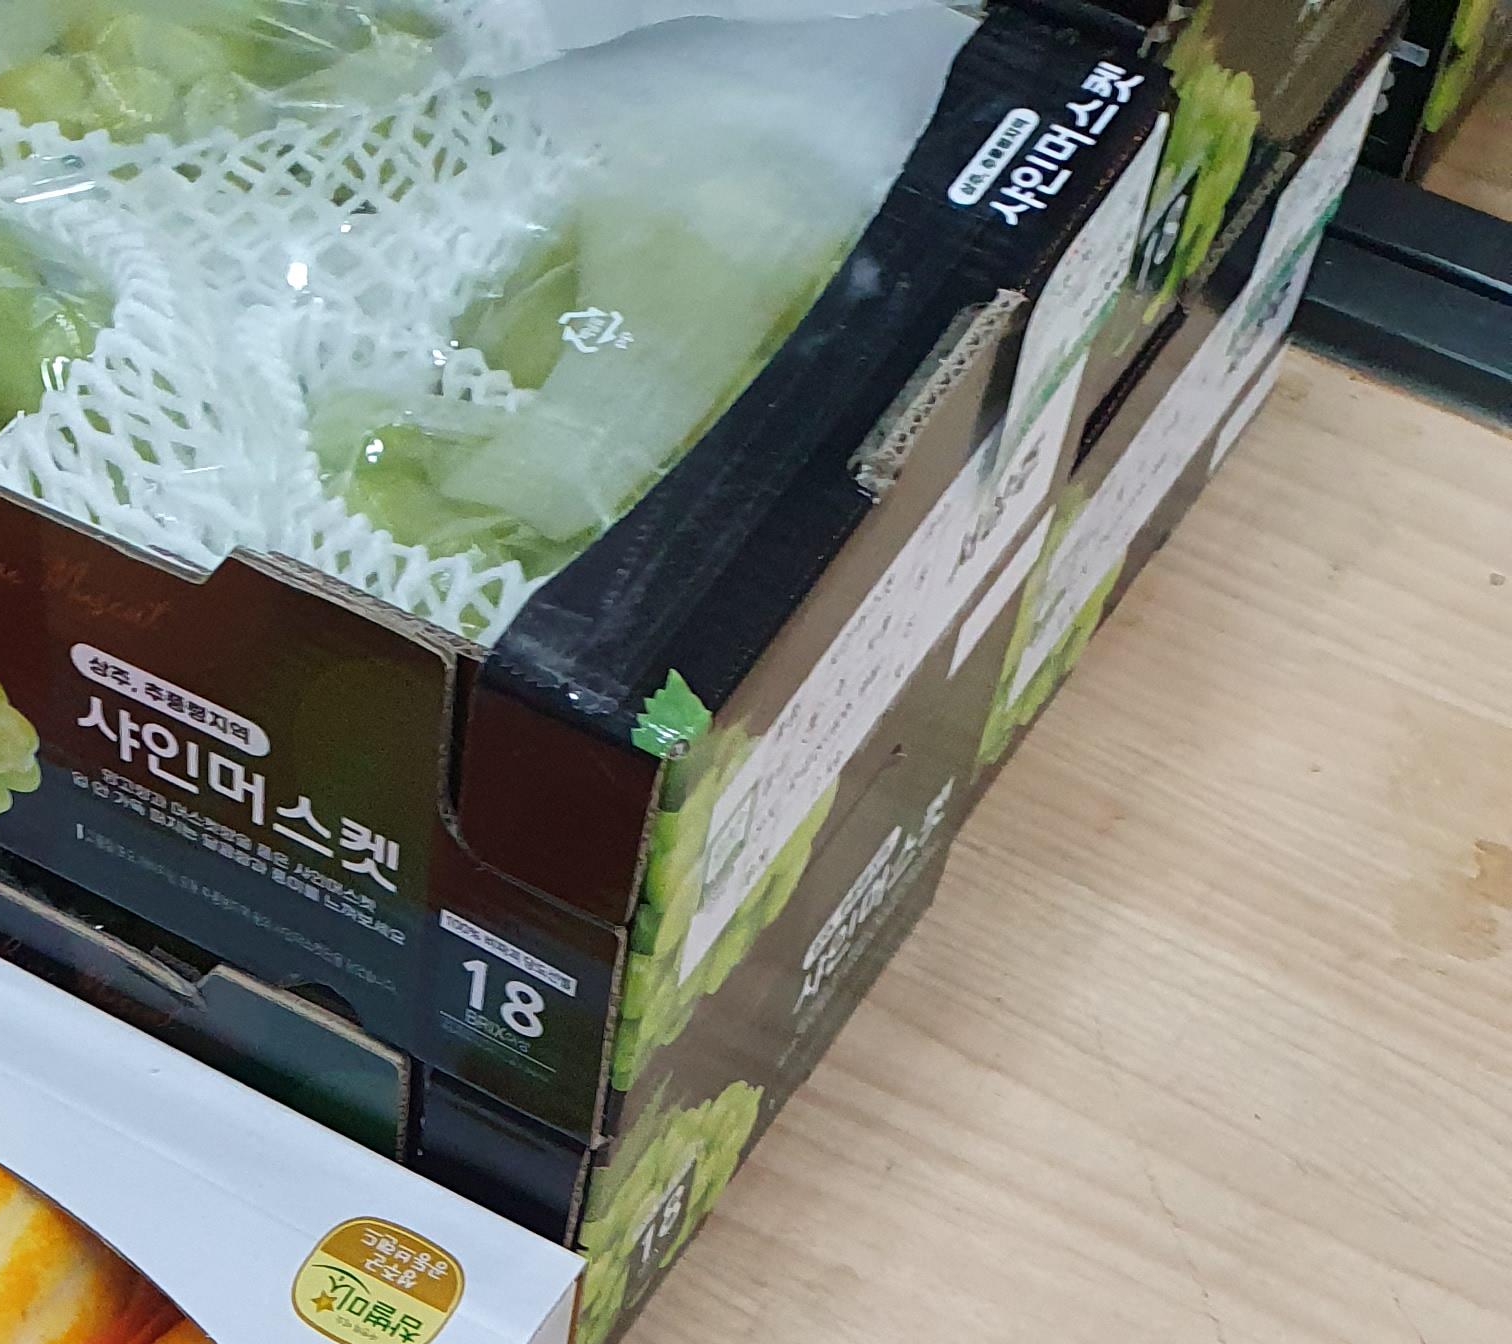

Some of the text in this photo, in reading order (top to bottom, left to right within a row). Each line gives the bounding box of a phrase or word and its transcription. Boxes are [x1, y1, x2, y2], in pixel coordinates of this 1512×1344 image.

[992, 62, 1144, 227] 샤인머스켓
[88, 655, 138, 694] 상주,
[77, 696, 400, 893] 샤인머스켓
[462, 959, 546, 1038] 18
[360, 1227, 449, 1282] 공동브랜드
[364, 1253, 419, 1290] 성주군
